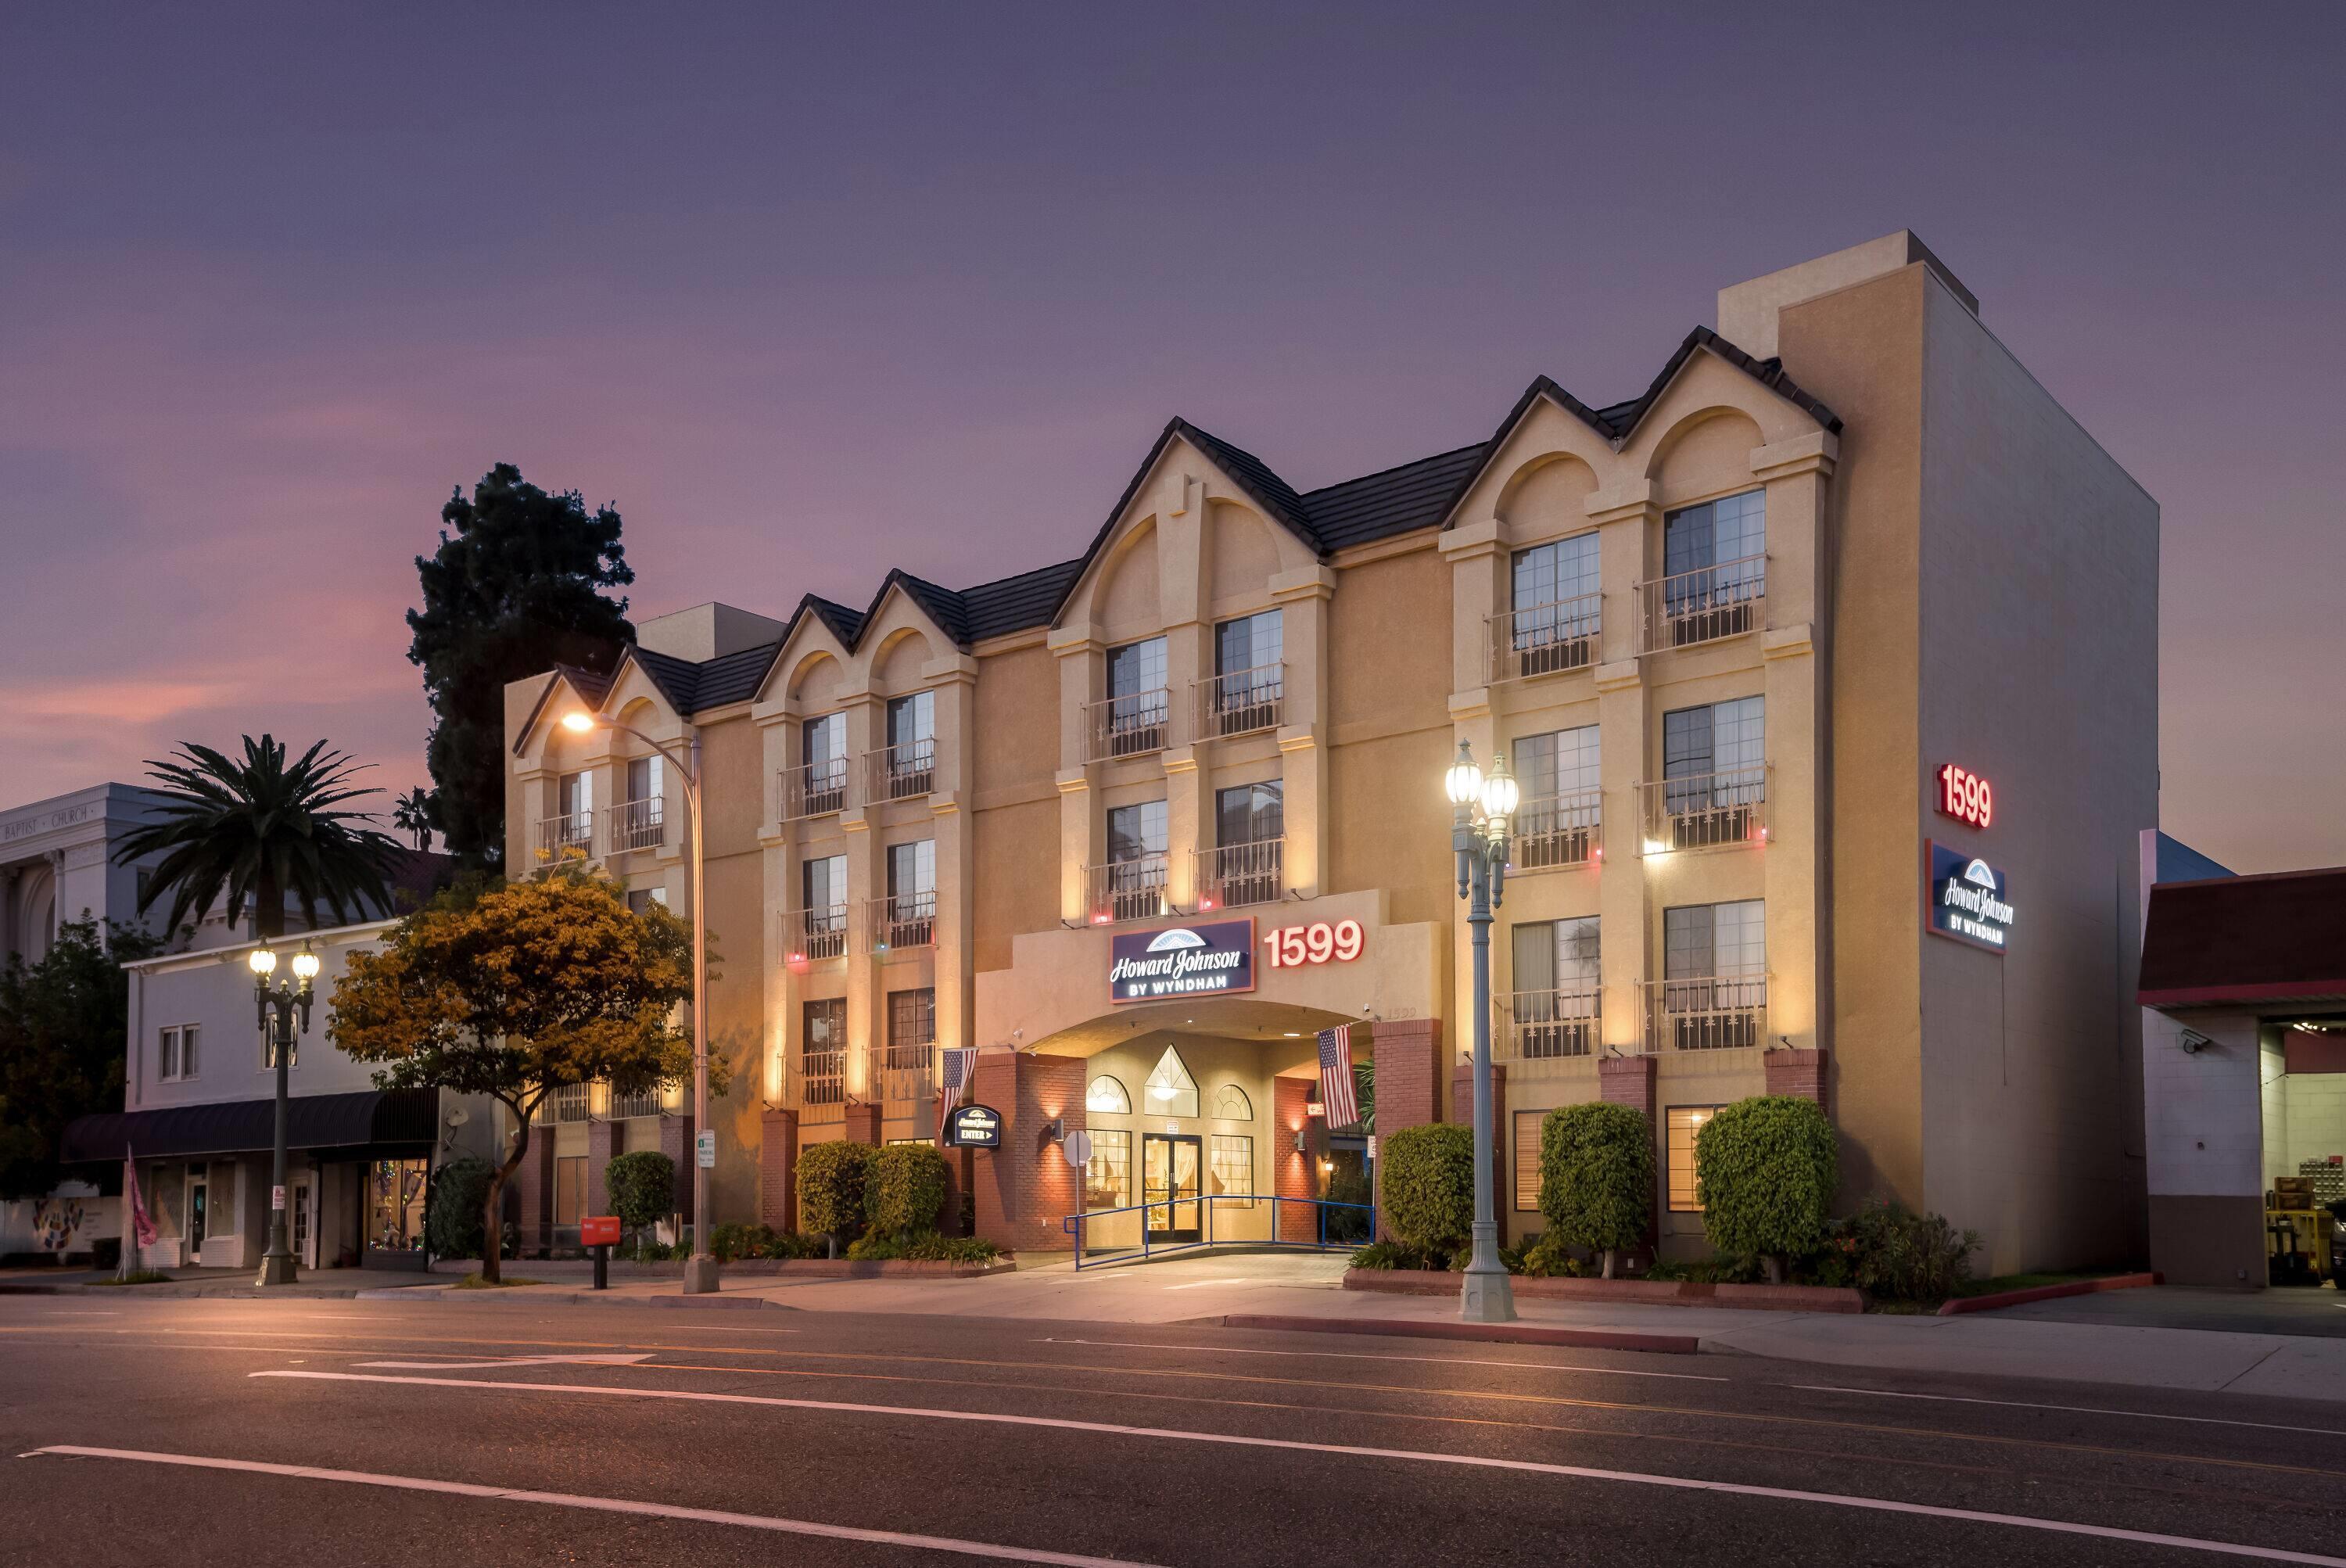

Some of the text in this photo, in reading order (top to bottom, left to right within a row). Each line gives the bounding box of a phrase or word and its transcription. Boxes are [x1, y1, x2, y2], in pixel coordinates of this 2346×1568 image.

[1942, 763, 1991, 828] 1599
[5, 806, 87, 840] BAPTIST CHURCH
[1945, 877, 2014, 925] Howard Johnson
[1264, 920, 1363, 967] 1599
[1950, 914, 2003, 945] BY WYNDHAM
[1110, 949, 1240, 983] Howard Johnson
[1128, 975, 1227, 996] BY WYNDHAM
[961, 1130, 985, 1139] ENTER
